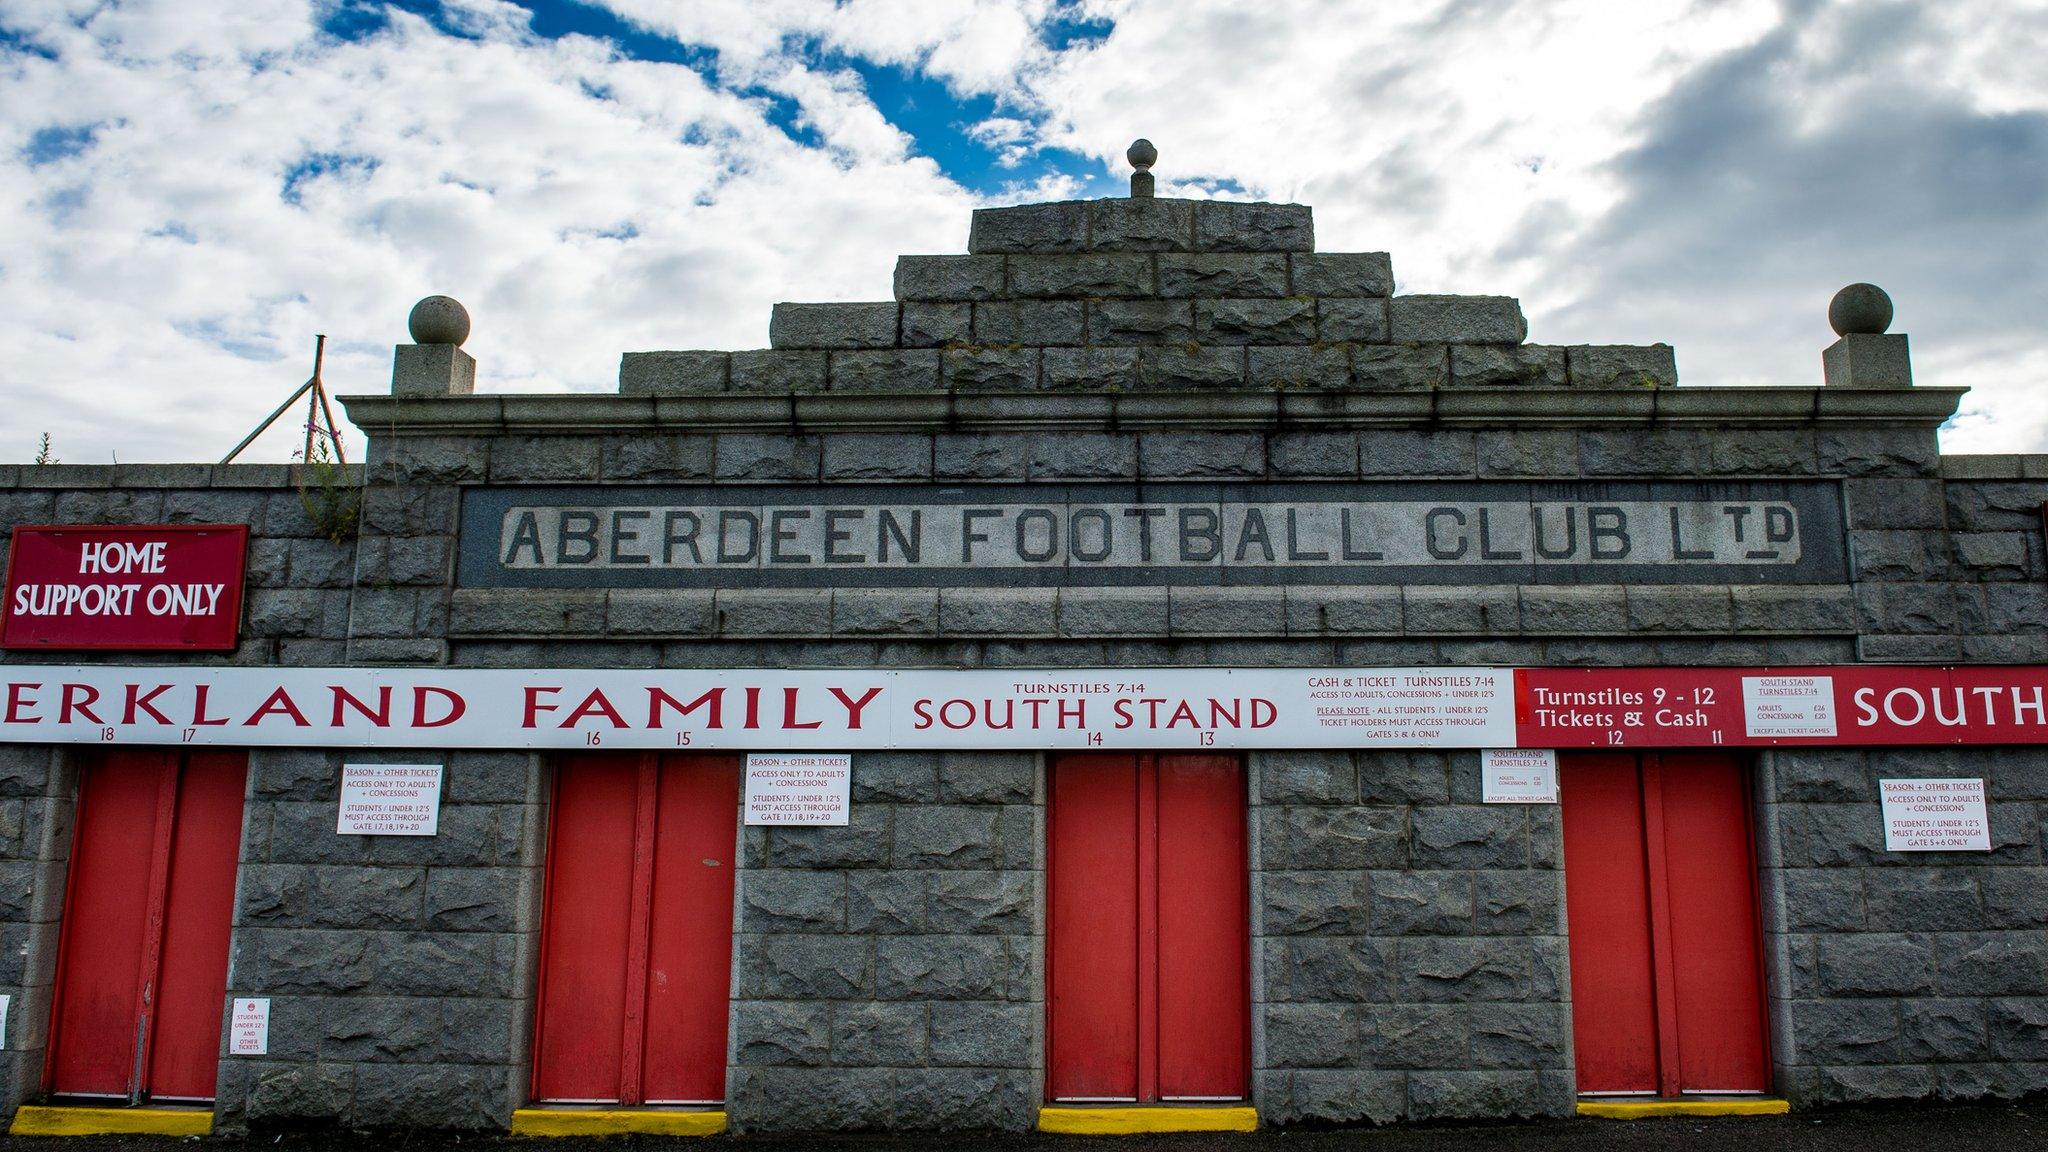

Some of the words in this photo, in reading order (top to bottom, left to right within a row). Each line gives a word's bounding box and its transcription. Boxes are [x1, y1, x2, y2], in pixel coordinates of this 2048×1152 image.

[504, 509, 922, 565] ABERDEEN
[961, 508, 1384, 563] FOOTBALL
[1425, 506, 1631, 560] CLUB
[79, 542, 167, 574] HOME
[14, 584, 142, 615] SUPPORT
[147, 584, 225, 615] ONLY
[1013, 683, 1110, 694] TURNSTILES
[1116, 683, 1146, 694] 7-14
[1308, 678, 1339, 687] CASH
[1343, 678, 1353, 687] &
[1357, 677, 1396, 687] TICKET
[1405, 677, 1471, 687] TURNSTILES
[1475, 677, 1495, 687] 7-14
[1354, 691, 1386, 699] ADULTS,
[1534, 688, 1643, 705] Turnstiles
[1653, 688, 1666, 705] 9
[1693, 688, 1716, 705] 12
[521, 686, 884, 730] FAMILY
[913, 698, 1086, 730] SOUTH
[1113, 698, 1278, 730] STAND
[1855, 686, 2046, 727] SOUTH
[1534, 709, 1613, 727] Tickets
[1624, 712, 1644, 727] &
[1655, 709, 1708, 727] Cash
[101, 728, 114, 741] 18
[182, 729, 196, 742] 17
[586, 731, 601, 746] 16
[677, 731, 691, 746] 15
[1087, 732, 1103, 746] 14
[1200, 732, 1214, 746] 13
[1608, 730, 1624, 745] 12
[1712, 730, 1723, 744] 11
